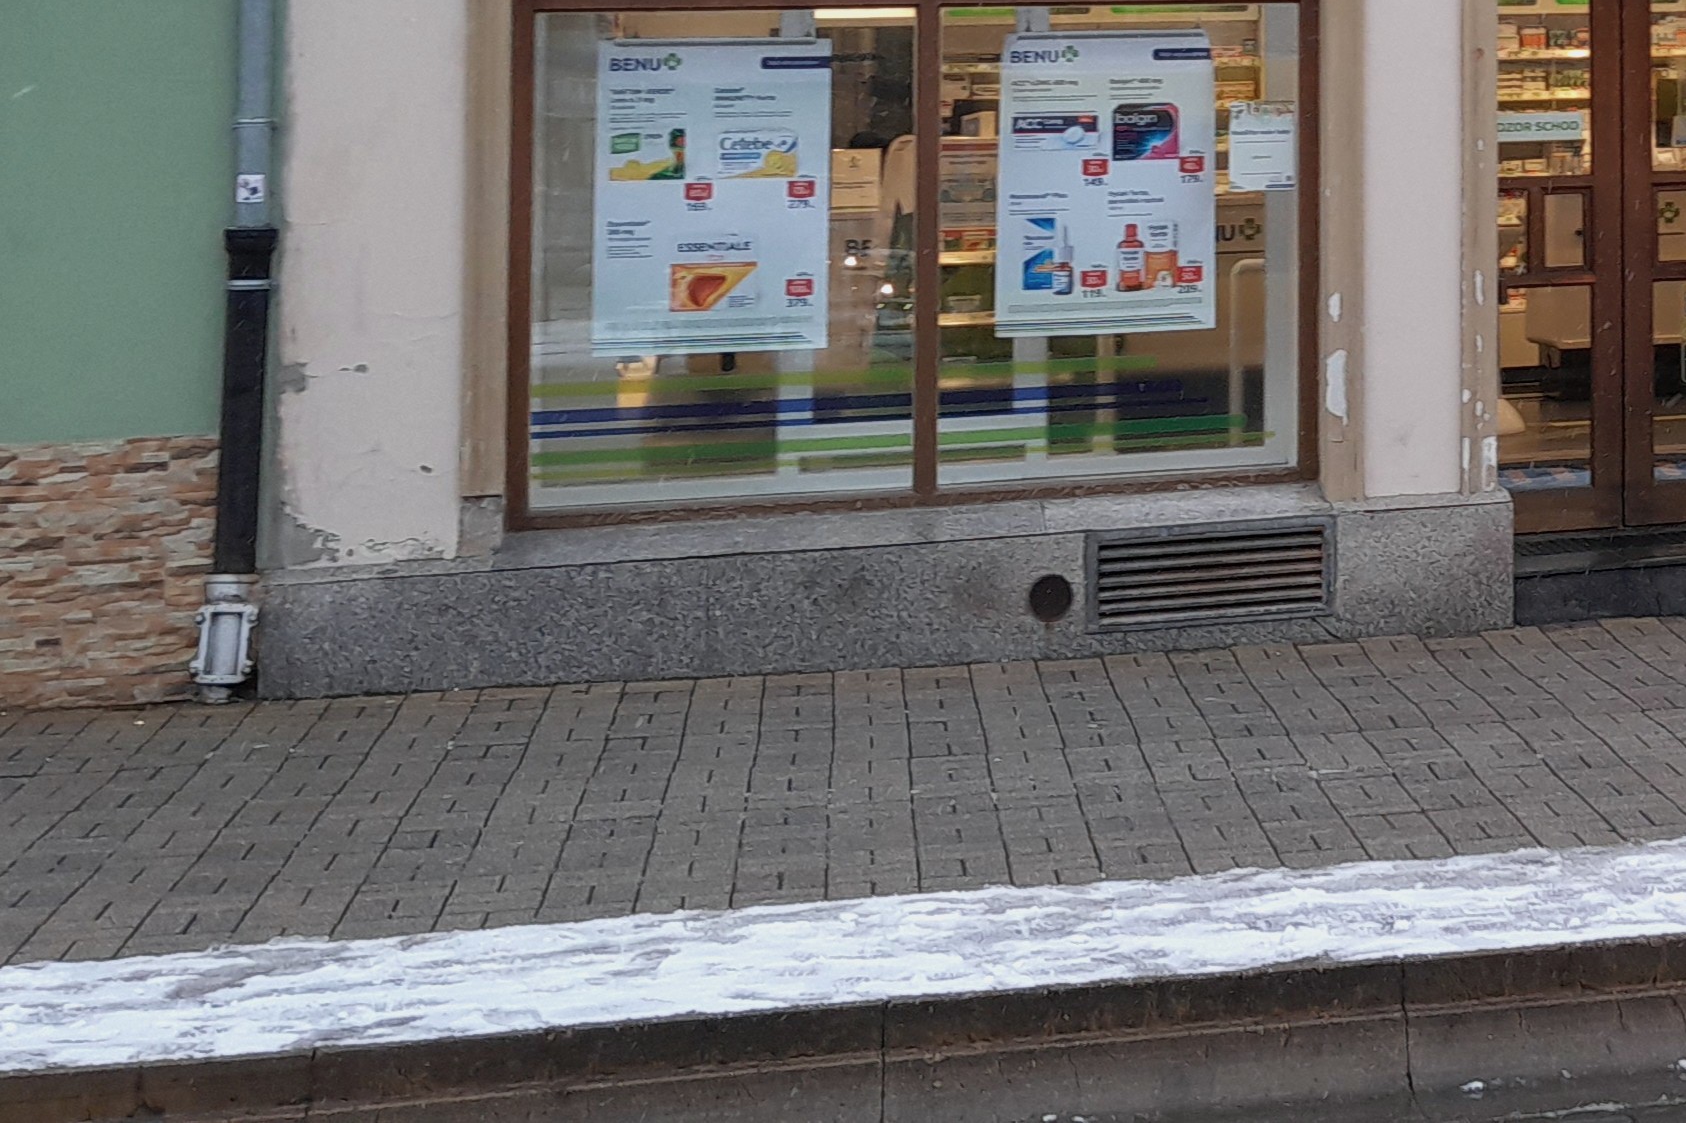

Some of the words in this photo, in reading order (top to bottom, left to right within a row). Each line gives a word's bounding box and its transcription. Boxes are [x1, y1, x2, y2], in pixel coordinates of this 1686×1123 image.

[1009, 50, 1060, 64] BENU
[608, 57, 662, 72] BENU
[1496, 121, 1532, 133] OZOR
[719, 136, 771, 151] Cetebe
[677, 241, 752, 253] ESSENTIALE
